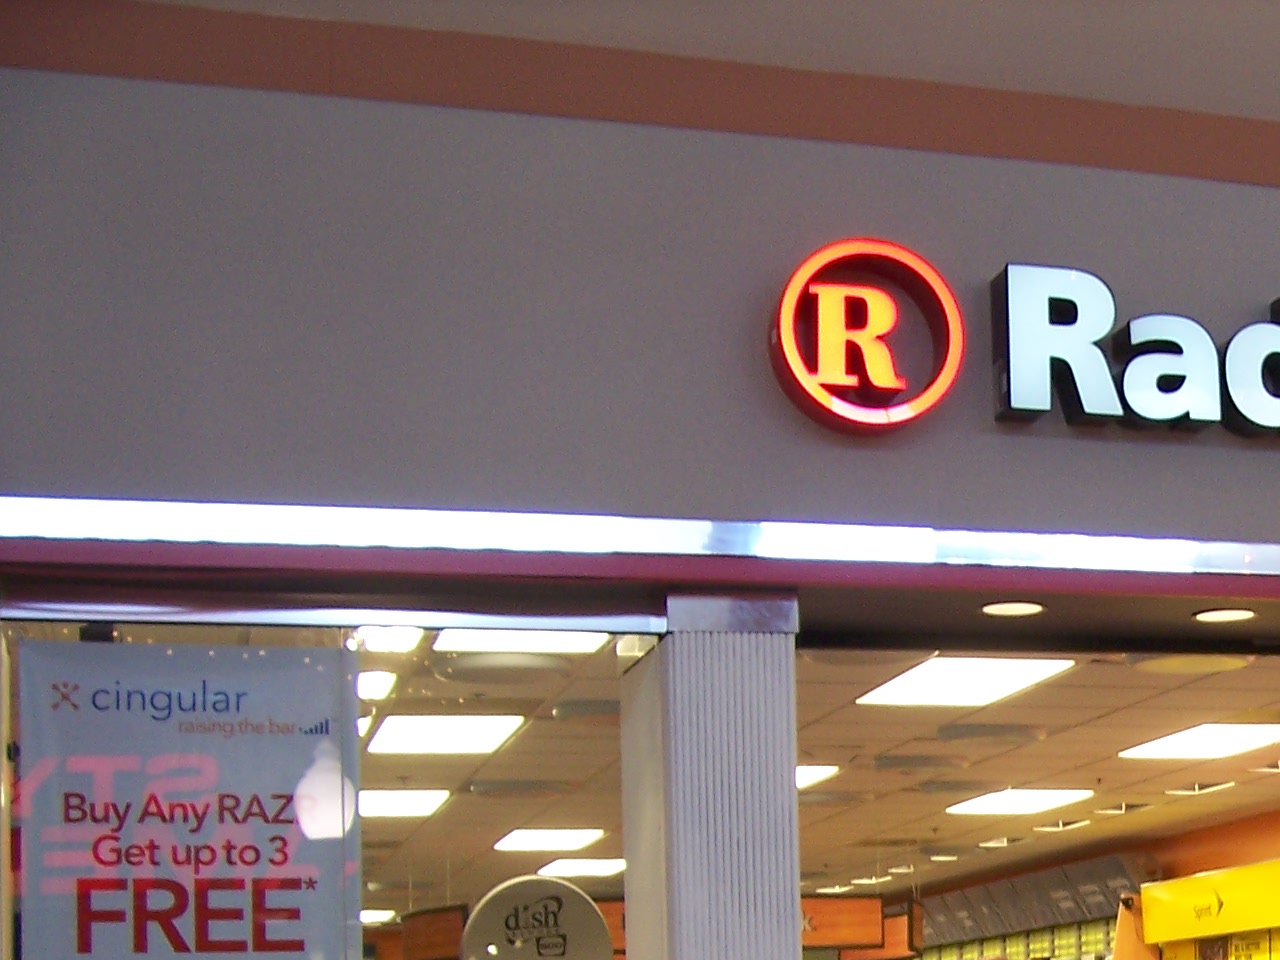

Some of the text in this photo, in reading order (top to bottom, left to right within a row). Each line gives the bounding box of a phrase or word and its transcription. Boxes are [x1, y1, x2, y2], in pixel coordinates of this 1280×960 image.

[92, 680, 248, 721] cingular
[178, 718, 297, 738] raising the bar
[63, 792, 131, 833] Buy
[138, 792, 211, 833] Any
[91, 834, 160, 868] Get
[172, 843, 218, 875] up
[226, 838, 261, 867] to
[268, 835, 289, 866] 3
